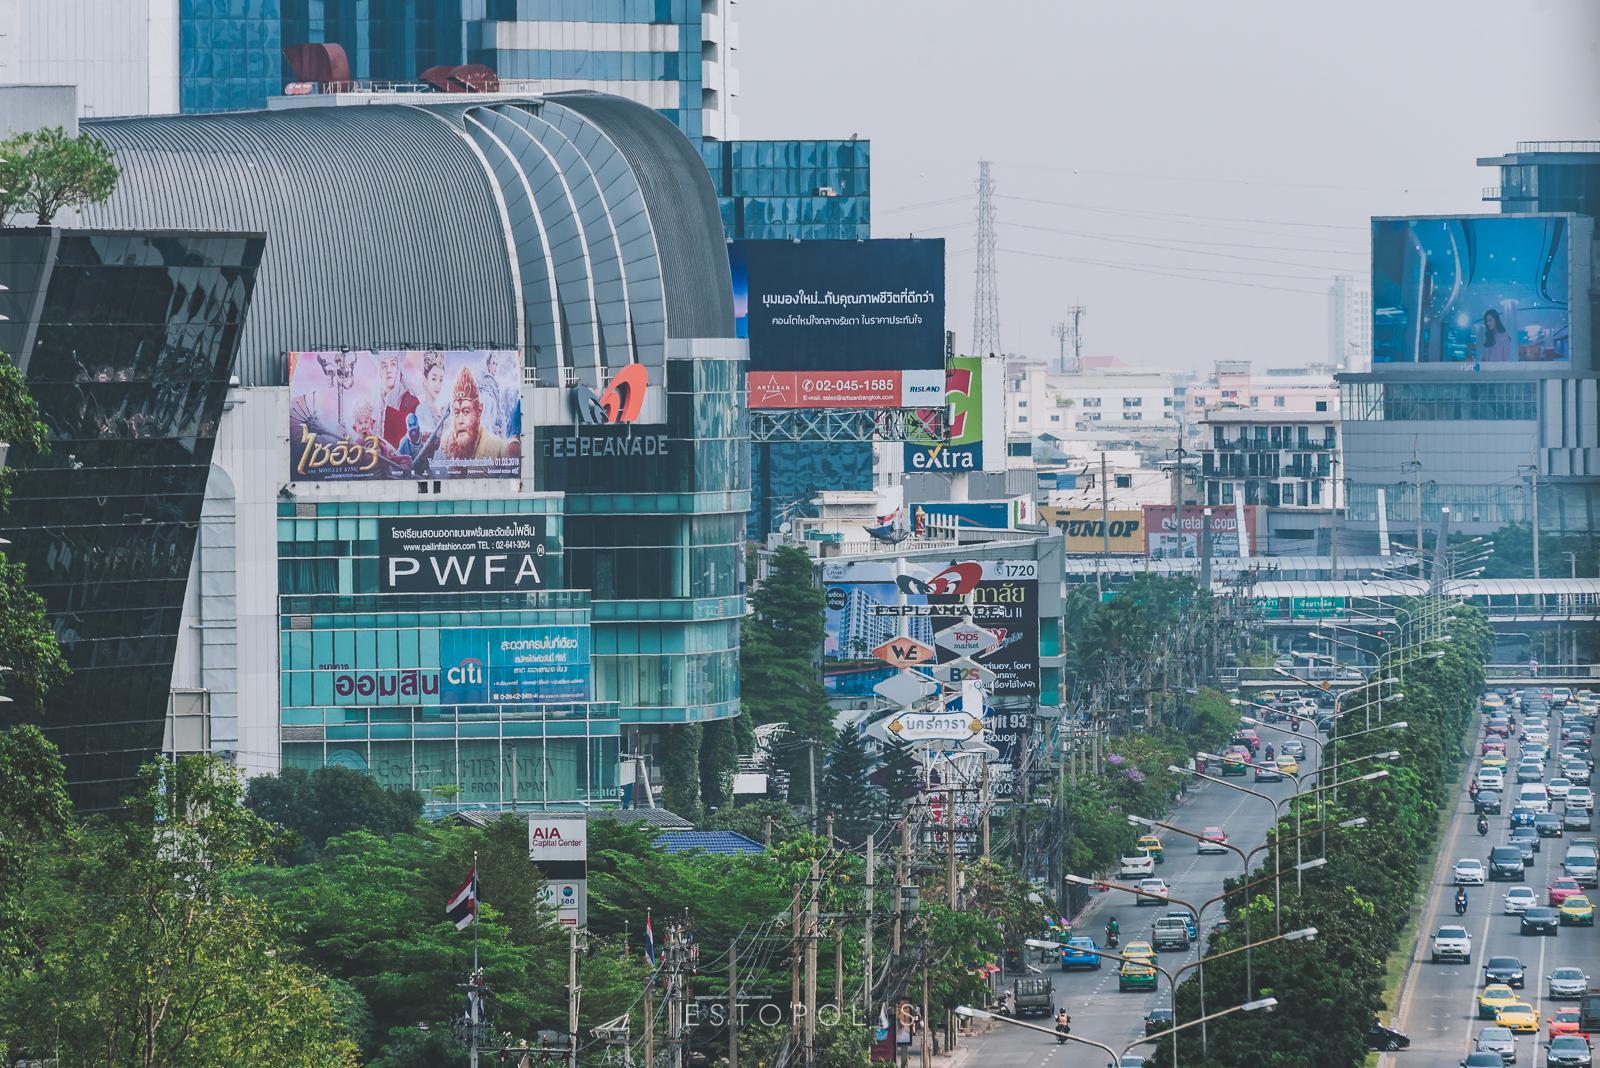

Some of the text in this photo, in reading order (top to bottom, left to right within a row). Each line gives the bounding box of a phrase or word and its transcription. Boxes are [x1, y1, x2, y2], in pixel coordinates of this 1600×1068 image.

[815, 380, 894, 391] 02-045-1585
[912, 443, 974, 469] extra
[403, 543, 476, 552] www.pailinfashion.com
[477, 541, 490, 550] TEL
[496, 541, 531, 549] 02-641-3054
[388, 554, 541, 586] PWFA
[1006, 566, 1035, 577] 1720
[954, 632, 979, 643] Tops
[891, 645, 917, 660] WE
[447, 661, 482, 684] citi
[950, 667, 980, 682] B2S
[335, 669, 439, 697] ออมสิน
[1009, 714, 1028, 728] 93
[471, 781, 504, 793] FROM
[533, 827, 561, 839] AIA
[532, 839, 582, 848] Capital Center
